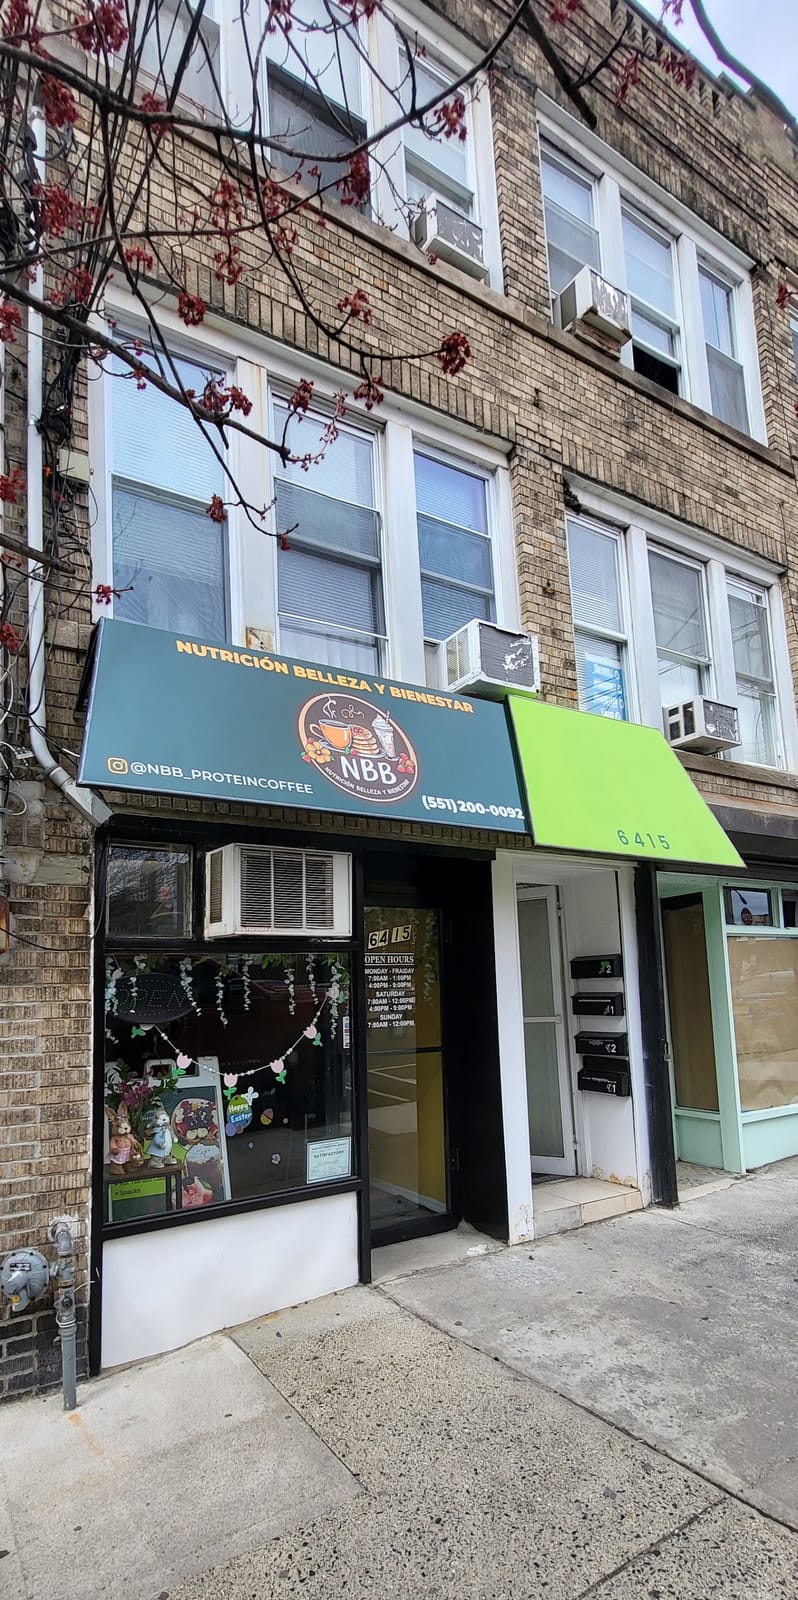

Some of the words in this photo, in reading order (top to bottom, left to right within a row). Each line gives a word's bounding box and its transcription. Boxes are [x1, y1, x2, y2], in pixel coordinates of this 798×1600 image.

[176, 639, 289, 675] NUTRICIÓN
[292, 664, 372, 693] BELLEZA
[373, 682, 385, 695] Y
[389, 685, 475, 714] BIENESTAR
[130, 761, 314, 794] @NBB_PROTEINCOFFEE
[324, 766, 355, 789] NUTRICIÓN
[356, 785, 381, 795] BELLEZA
[340, 755, 397, 785] NBB
[617, 829, 670, 850] 6415
[369, 926, 411, 948] 6415
[364, 955, 386, 964] OPEN
[387, 955, 414, 964] HOURS
[375, 990, 406, 998] SATURDAY
[379, 1013, 403, 1021] SUNDAY
[230, 1112, 252, 1123] Easter
